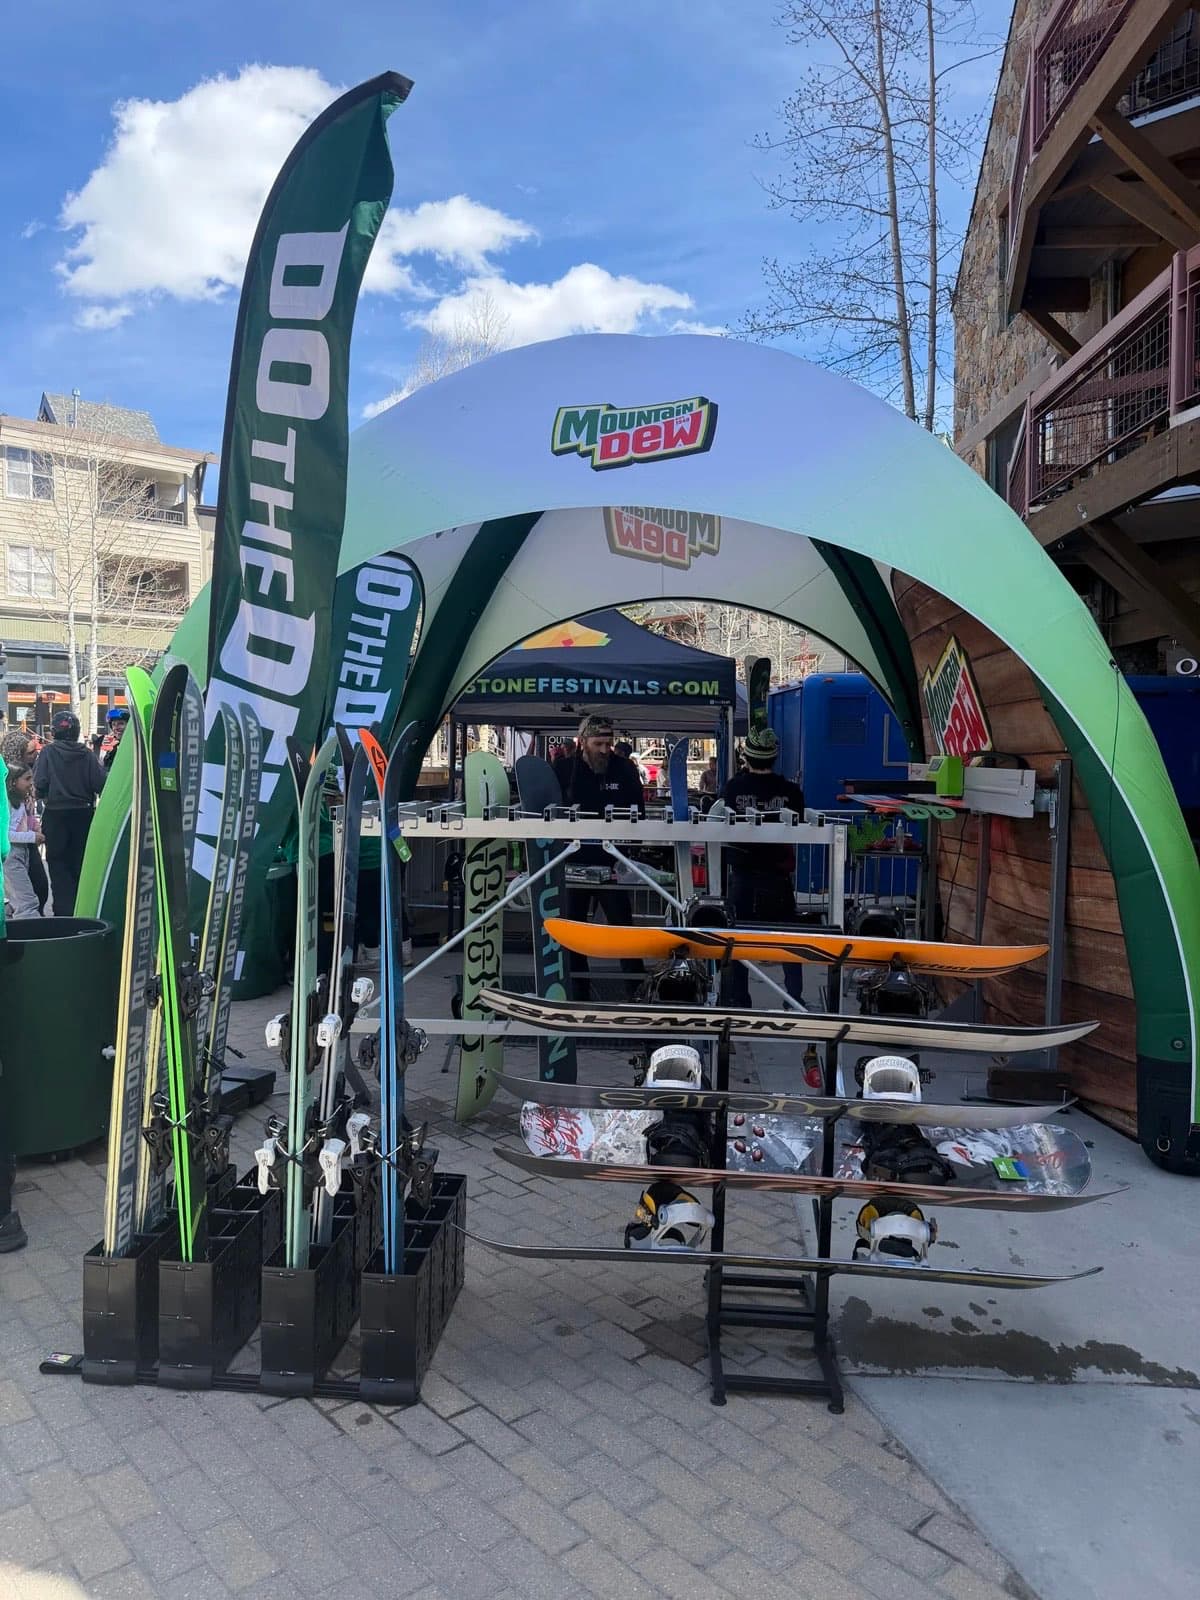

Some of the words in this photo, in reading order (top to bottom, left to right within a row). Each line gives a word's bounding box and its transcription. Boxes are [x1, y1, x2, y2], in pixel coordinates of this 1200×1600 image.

[256, 218, 350, 420] DO
[240, 427, 298, 602] THE
[340, 612, 391, 689] THE
[185, 693, 200, 756] DEW
[137, 864, 155, 930] DEW
[506, 1002, 798, 1031] SALOMON
[126, 1024, 144, 1092] DEW
